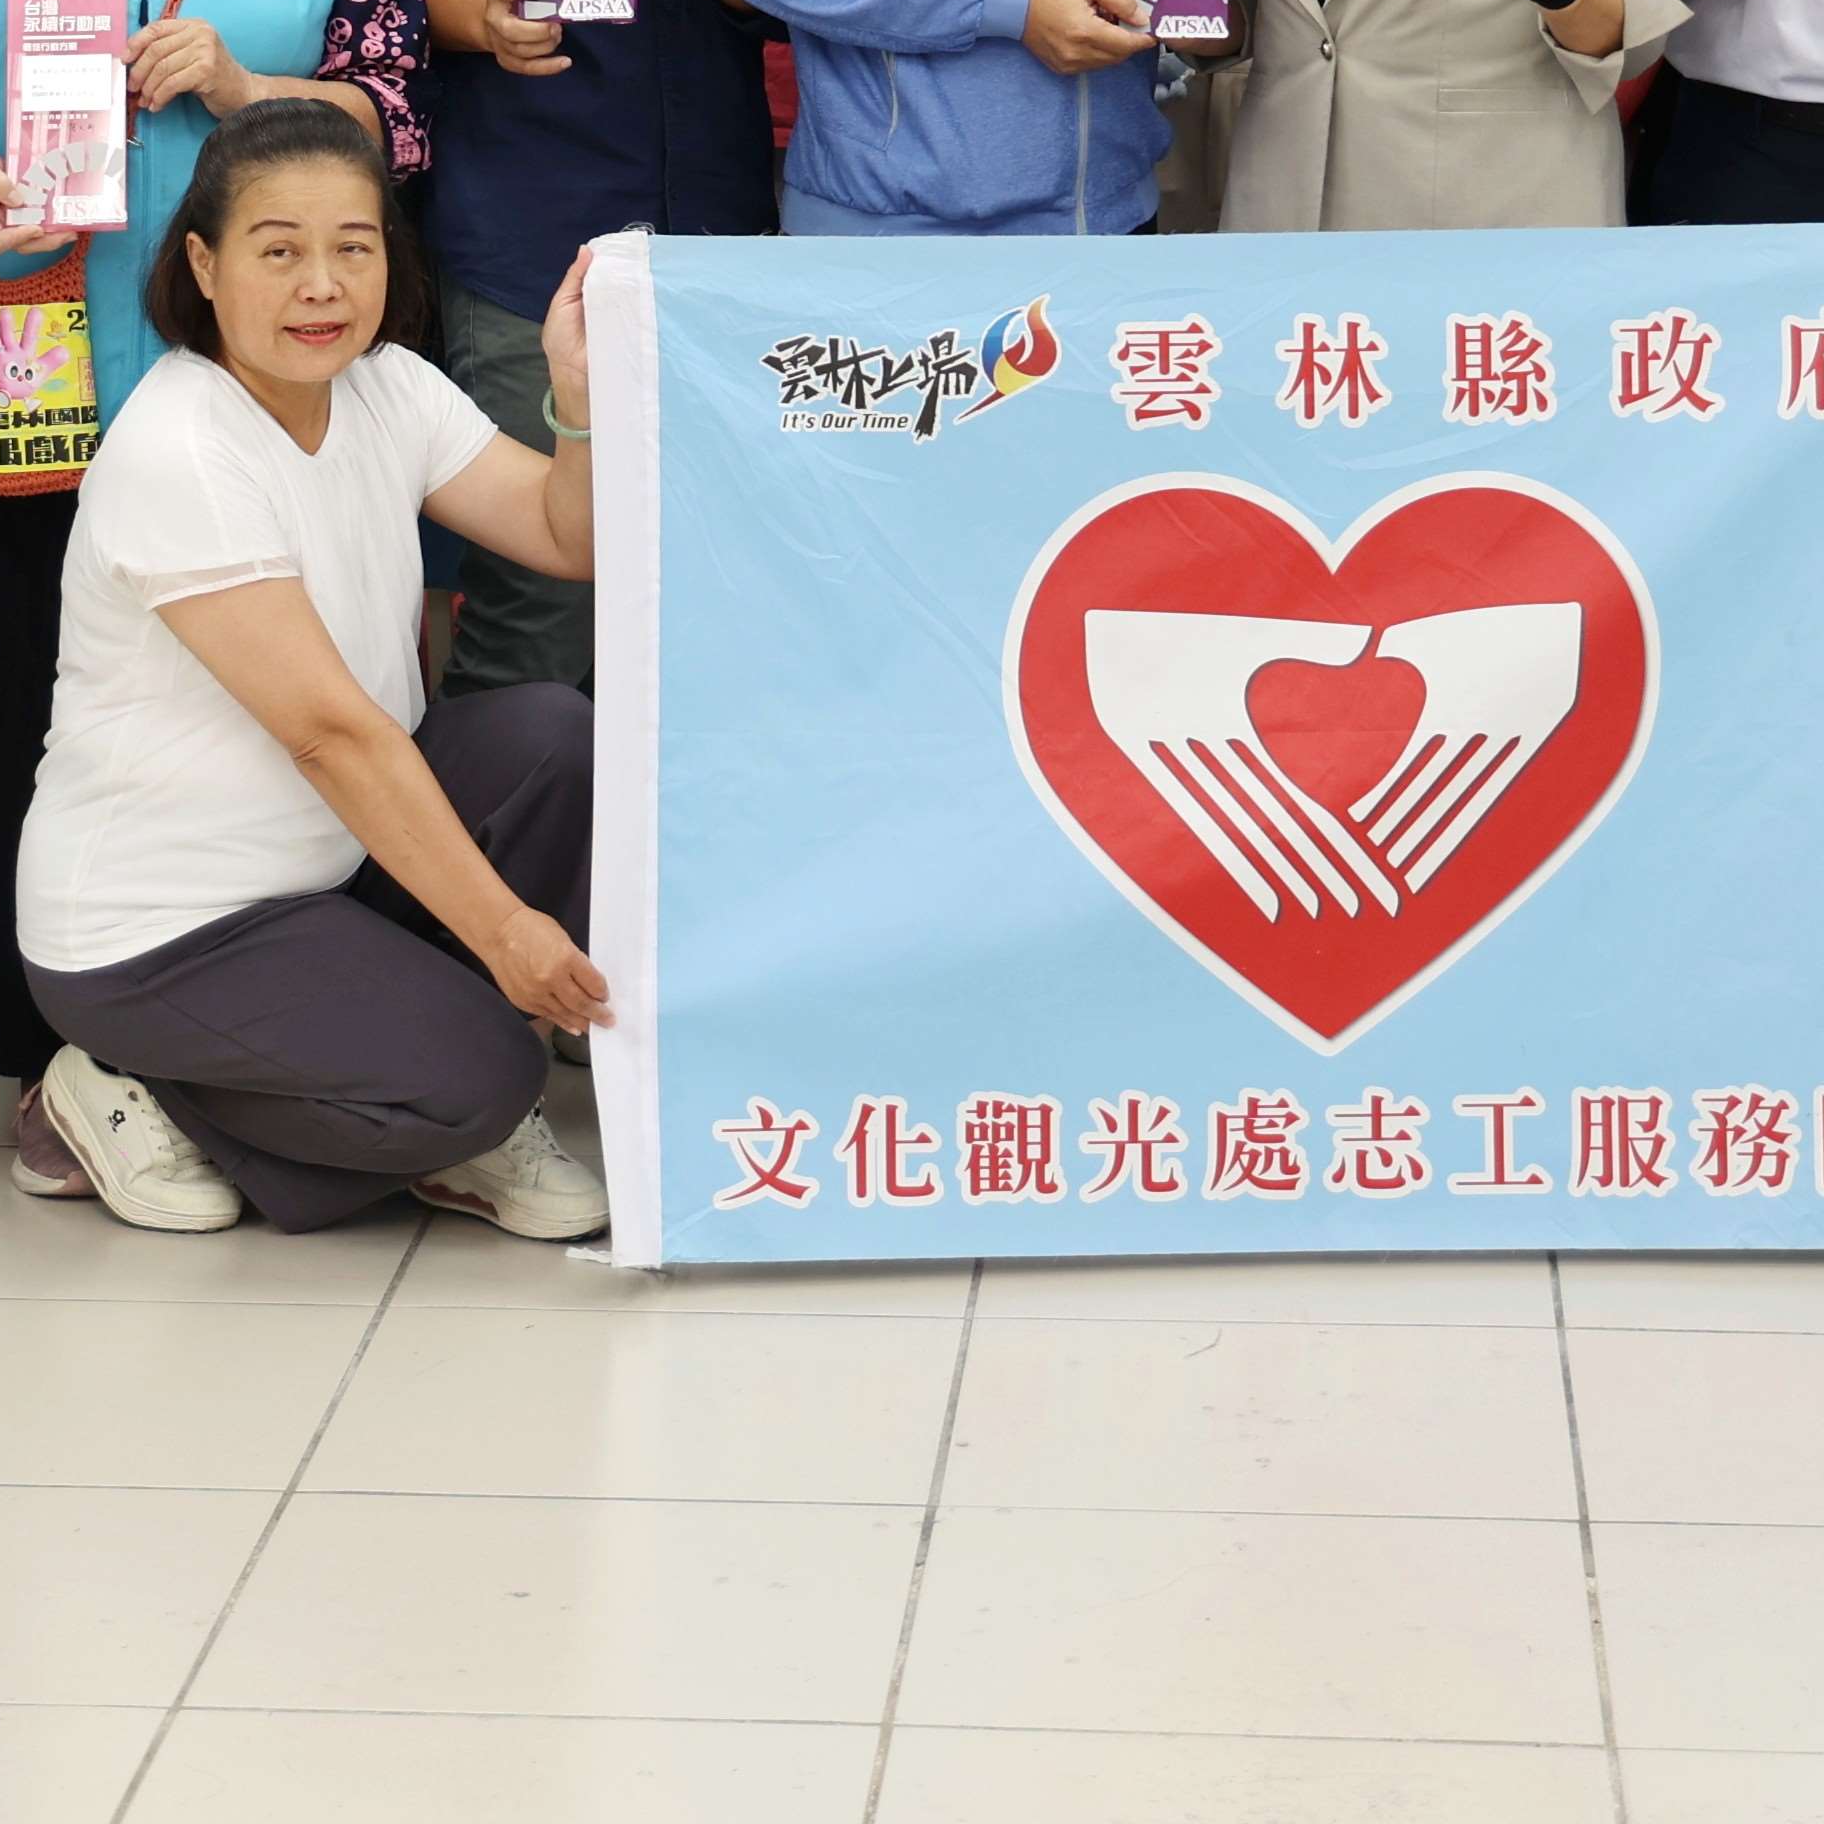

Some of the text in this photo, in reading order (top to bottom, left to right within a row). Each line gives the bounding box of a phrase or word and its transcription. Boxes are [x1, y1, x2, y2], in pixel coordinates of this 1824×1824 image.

[564, 0, 628, 14] APSAA
[1160, 20, 1225, 34] APSAA
[67, 310, 89, 332] 2
[761, 330, 978, 441] 雲林上場
[782, 413, 909, 430] It's Our Time
